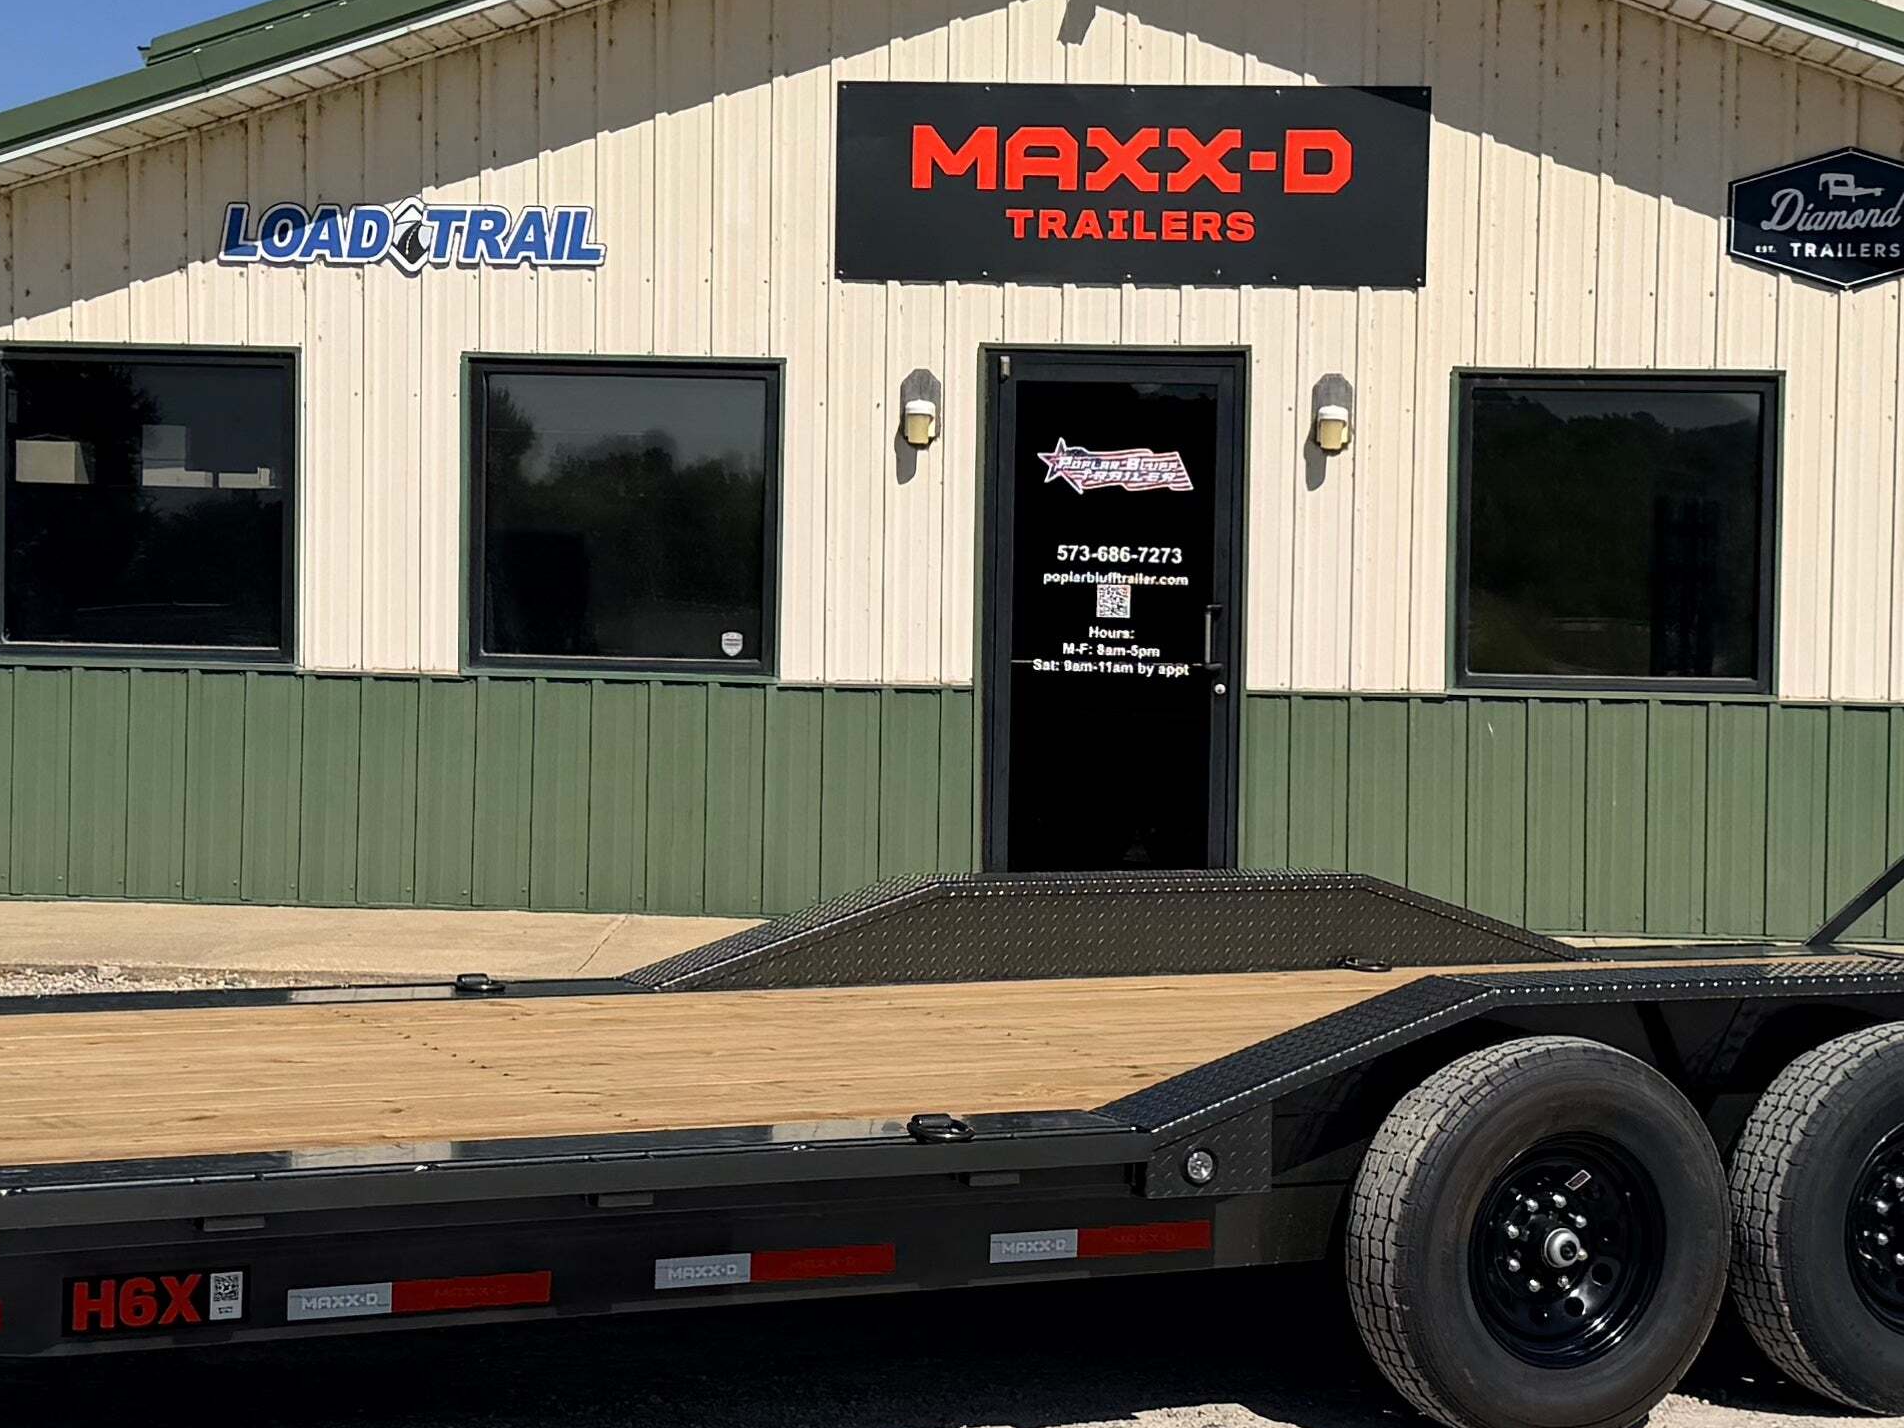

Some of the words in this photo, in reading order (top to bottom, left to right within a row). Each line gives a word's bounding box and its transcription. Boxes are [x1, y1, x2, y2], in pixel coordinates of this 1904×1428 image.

[911, 124, 1353, 194] MAXX-D
[222, 206, 391, 260] LOAD
[425, 208, 606, 261] TRAIL
[1004, 208, 1256, 242] TRAILERS
[1789, 242, 1901, 258] TRAILERS
[1056, 544, 1183, 564] 573-686-7273
[1088, 625, 1136, 640] Hours:
[1062, 642, 1093, 656] M-F:
[1096, 643, 1161, 660] 8am-5pm
[1032, 658, 1060, 672] Sat:
[1137, 662, 1154, 678] by
[1158, 664, 1190, 678] appt
[71, 1273, 203, 1332] H6X
